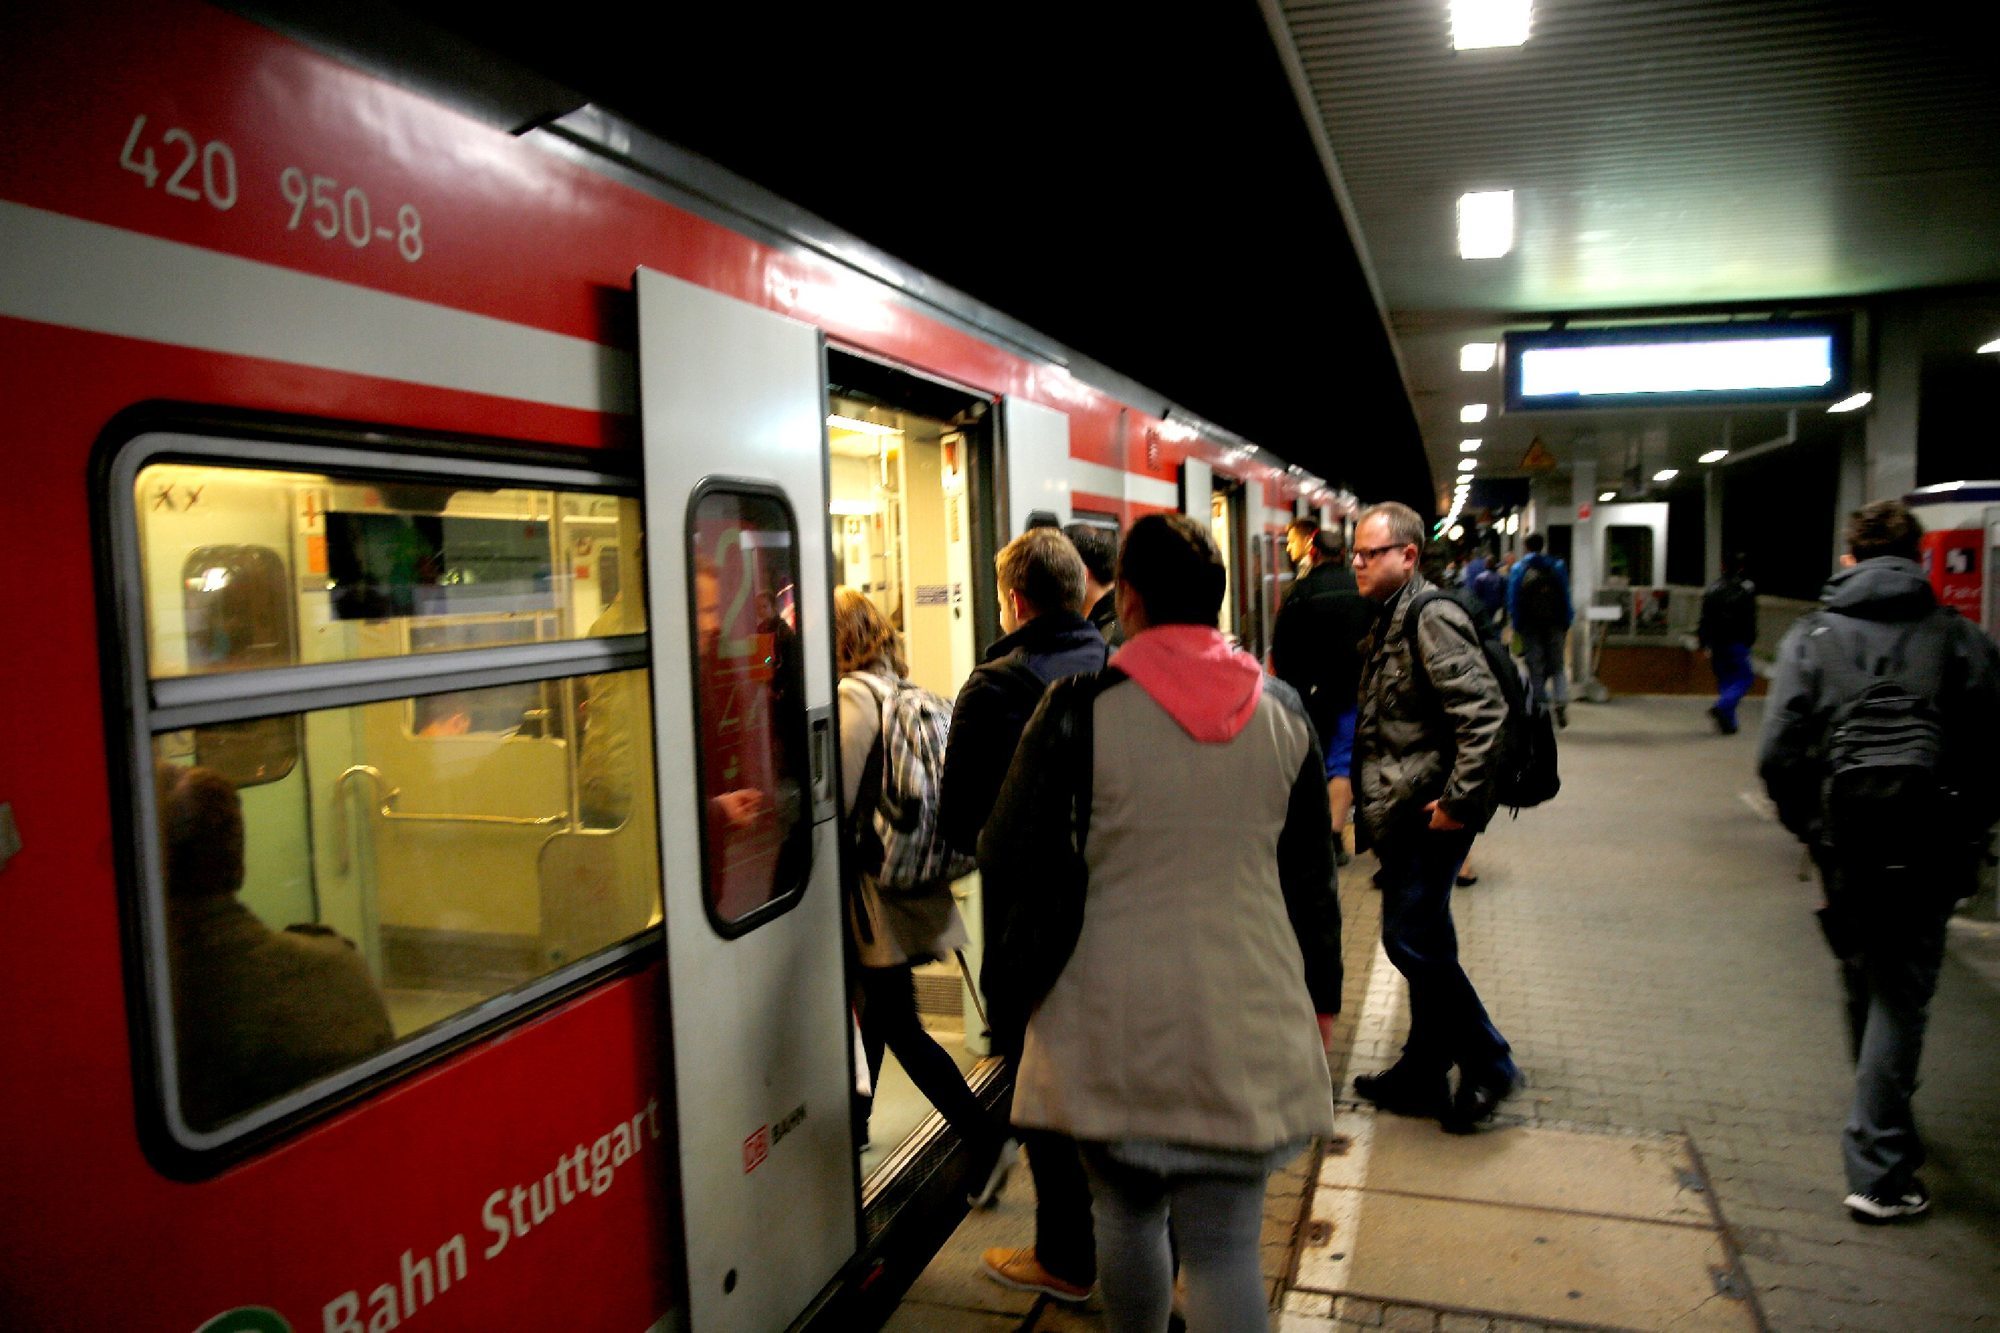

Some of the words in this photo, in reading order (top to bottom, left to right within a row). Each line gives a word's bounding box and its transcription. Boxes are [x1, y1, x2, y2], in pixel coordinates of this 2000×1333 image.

[120, 114, 238, 211] 420
[281, 166, 424, 263] 950-8
[715, 527, 759, 660] 2
[322, 1233, 468, 1333] Bahn
[482, 1098, 661, 1260] Stuttgart
